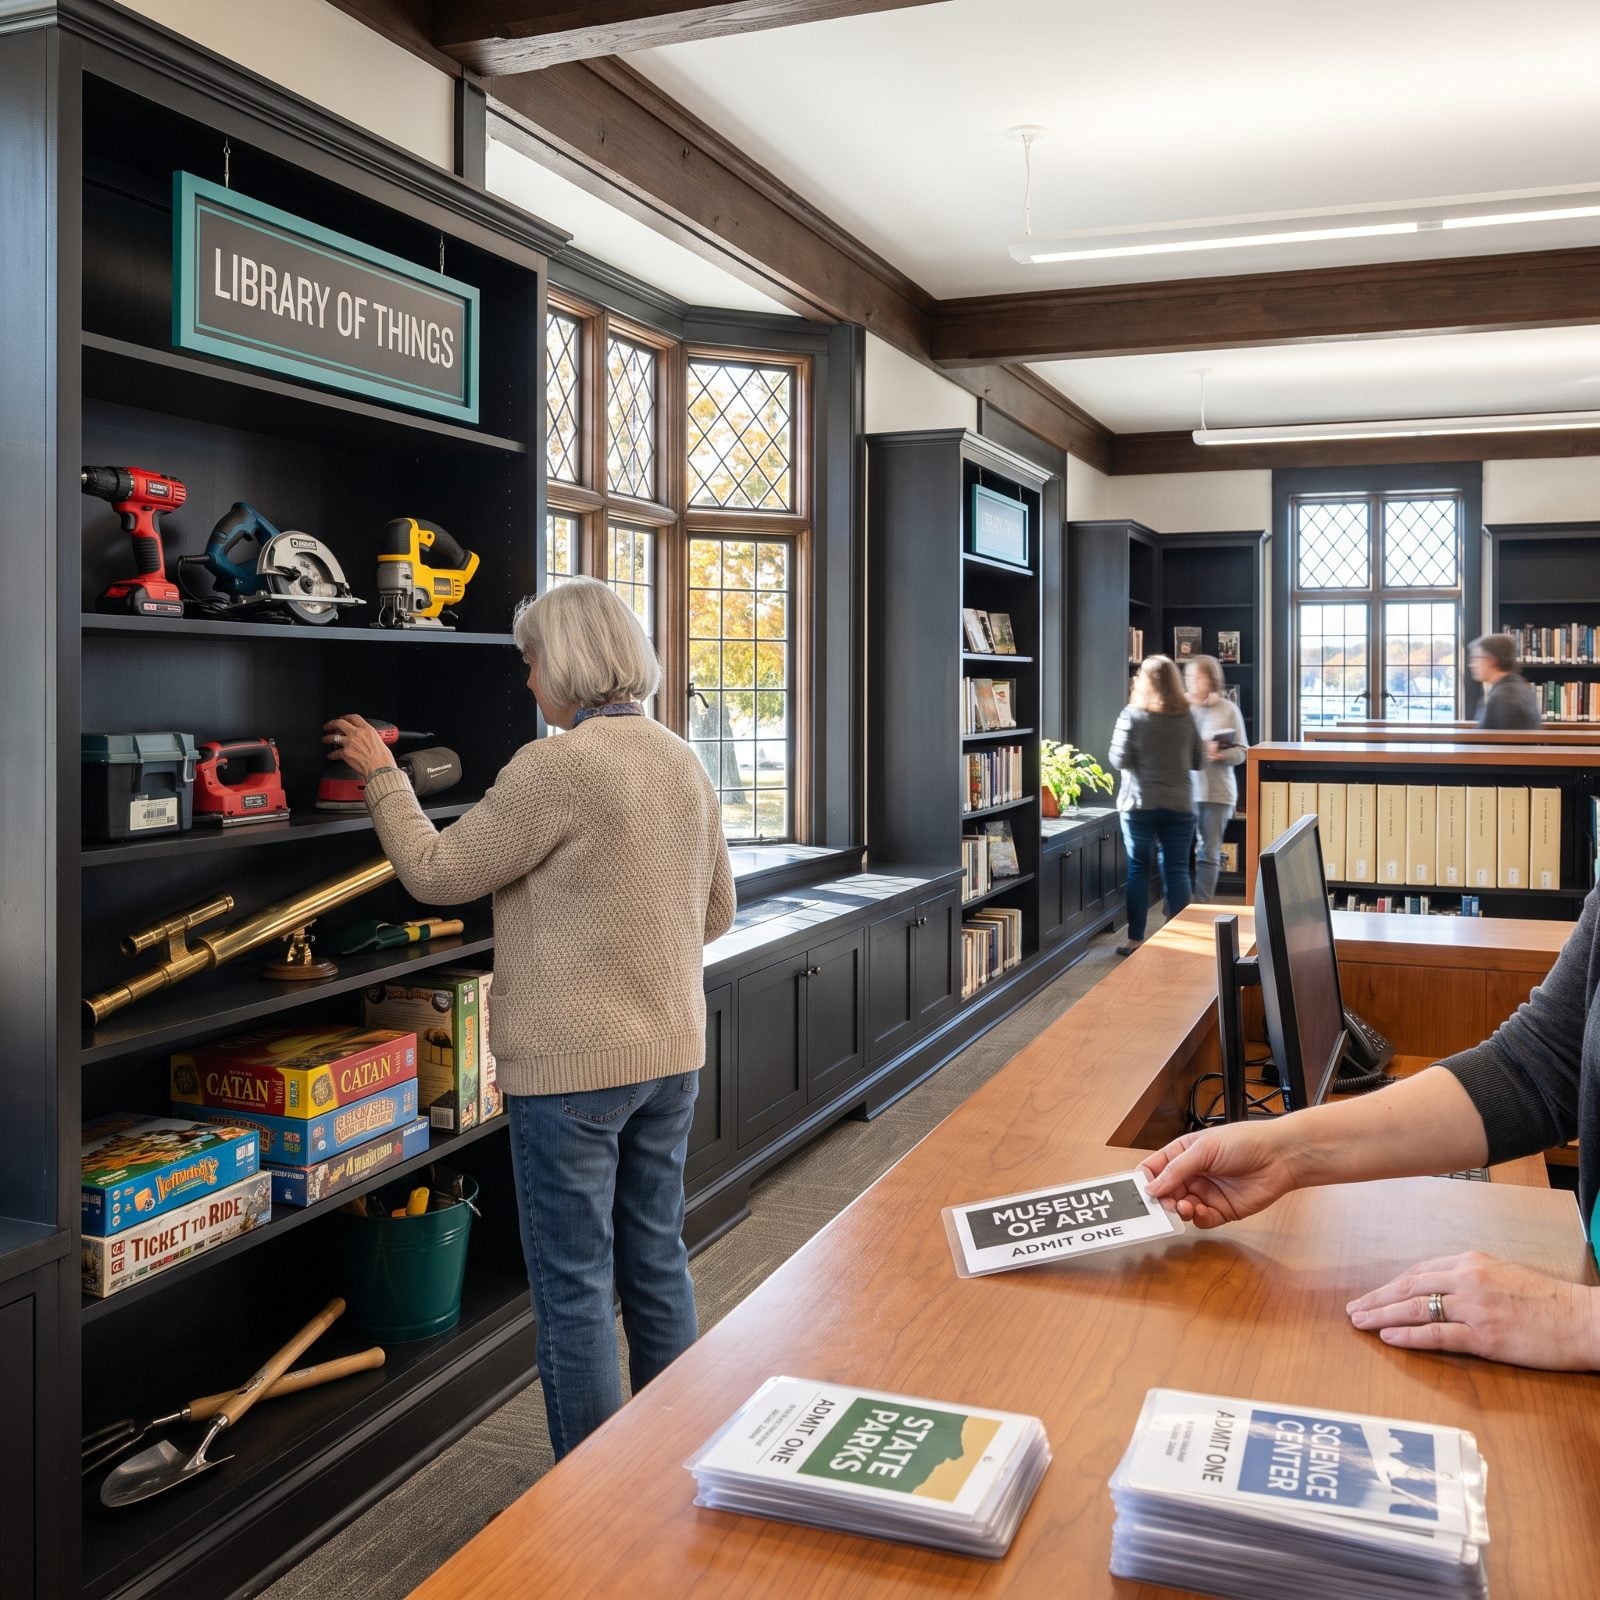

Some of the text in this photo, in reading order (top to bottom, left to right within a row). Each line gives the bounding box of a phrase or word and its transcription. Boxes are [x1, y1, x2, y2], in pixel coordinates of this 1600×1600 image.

[215, 247, 454, 369] LIBRARY OF THINGS
[206, 1072, 270, 1103] CATAN
[340, 1054, 392, 1093] CATAN
[131, 1197, 243, 1262] TICKET TO RIDE
[992, 1189, 1114, 1226] MUSEUM
[1007, 1205, 1111, 1237] OF ART
[1011, 1226, 1124, 1258] ADMIT ONE
[795, 1398, 836, 1438] ADMIT
[829, 1408, 900, 1473] PARKS
[769, 1437, 804, 1465] ONE
[866, 1415, 935, 1480] STATE
[1202, 1409, 1236, 1484] ADMIT ONE
[1267, 1420, 1306, 1493] CENTER
[1305, 1423, 1341, 1500] SCIENCE
